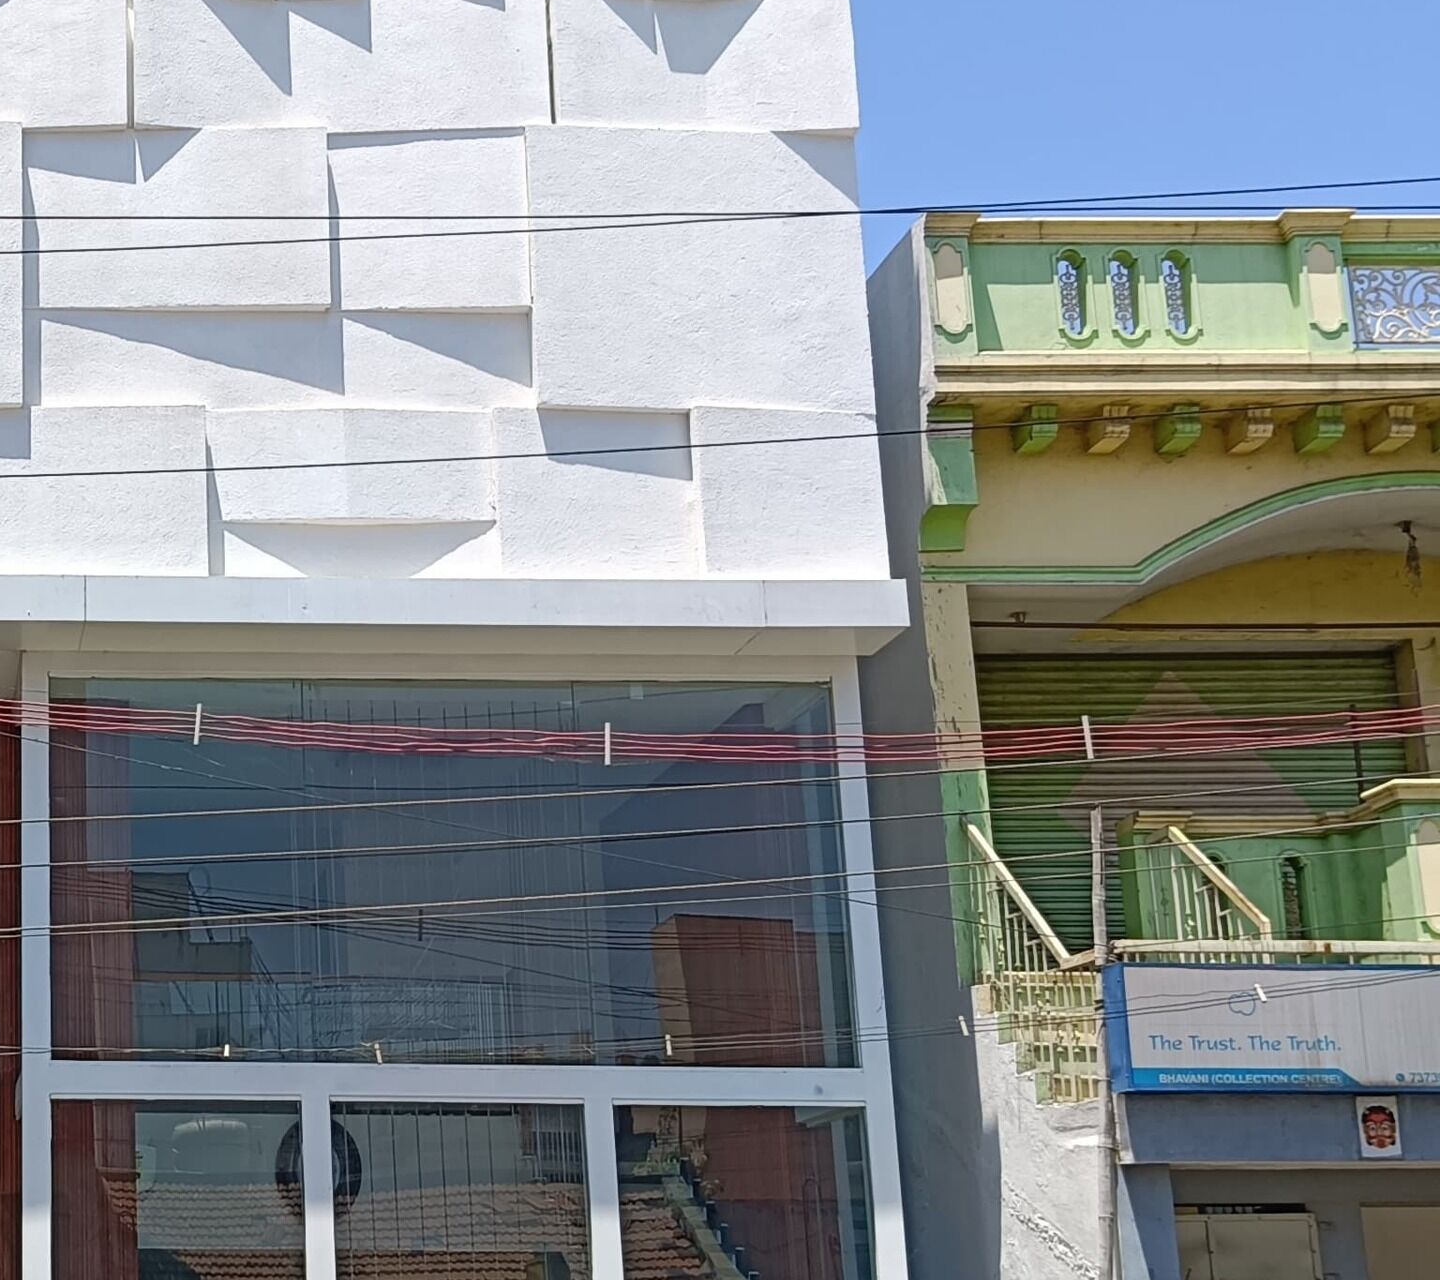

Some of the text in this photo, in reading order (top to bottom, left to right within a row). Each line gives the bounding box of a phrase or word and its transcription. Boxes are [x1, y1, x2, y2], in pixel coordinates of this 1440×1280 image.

[1147, 1034, 1342, 1051] The Trust. The Truth.
[1159, 1072, 1208, 1085] BHAVANI
[1211, 1072, 1288, 1086] (COLLECTION
